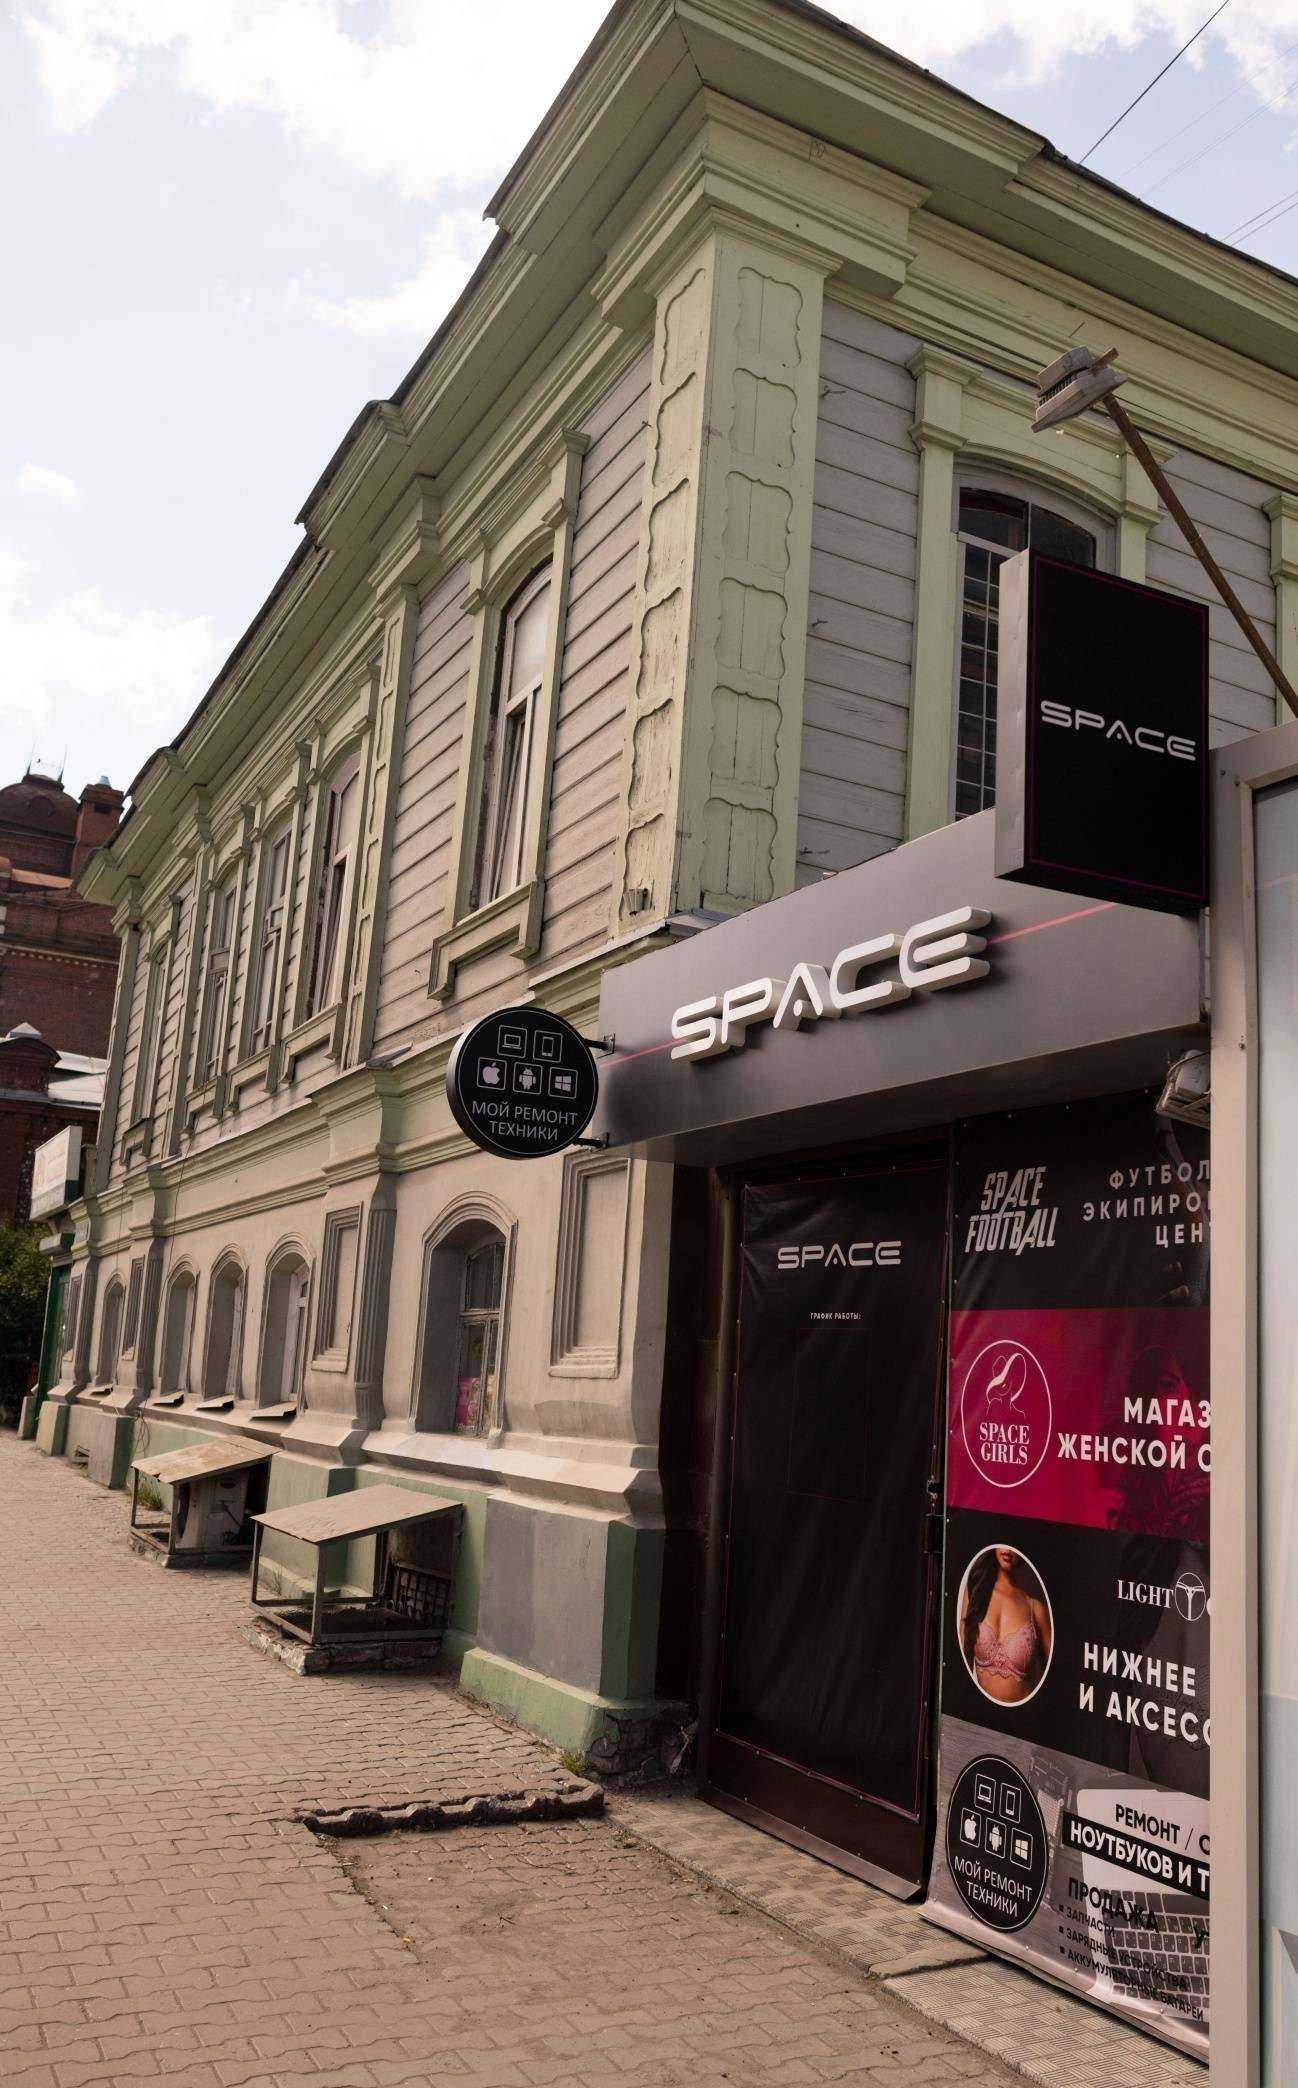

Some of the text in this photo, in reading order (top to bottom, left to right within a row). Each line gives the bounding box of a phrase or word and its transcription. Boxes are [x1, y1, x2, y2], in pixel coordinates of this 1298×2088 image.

[1040, 700, 1197, 762] SPACE
[670, 905, 992, 1062] SPACE
[472, 1100, 578, 1126] МОЙ РЕМОНТ
[489, 1120, 558, 1141] ТЕХНИКИ
[981, 1166, 1047, 1214] SPACE
[1082, 1191, 1211, 1221] ЭКИПИРО
[964, 1207, 1059, 1256] FOOTBALL
[1155, 1222, 1211, 1248] ЦЕН
[777, 1241, 902, 1270] SPACE
[980, 1421, 1030, 1445] SPACE
[1057, 1432, 1186, 1470] ЖЕНСКОЙ
[981, 1442, 1028, 1466] GIRLS
[1117, 1579, 1174, 1609] LIGHT
[1083, 1641, 1196, 1697] НИЖНЕЕ
[1079, 1682, 1094, 1713] И
[1115, 1803, 1181, 1845] РЕМОНТ
[1070, 1820, 1174, 1880] НОУТБУКОВ
[1178, 1861, 1192, 1888] И
[954, 1855, 1033, 1902] МОЙ РЕМОНТ
[966, 1880, 1018, 1918] ТЕХНИКИ
[1068, 1876, 1160, 1934] ПРОДАЖА
[1066, 1906, 1116, 1938] ЗАПЧАСТИ
